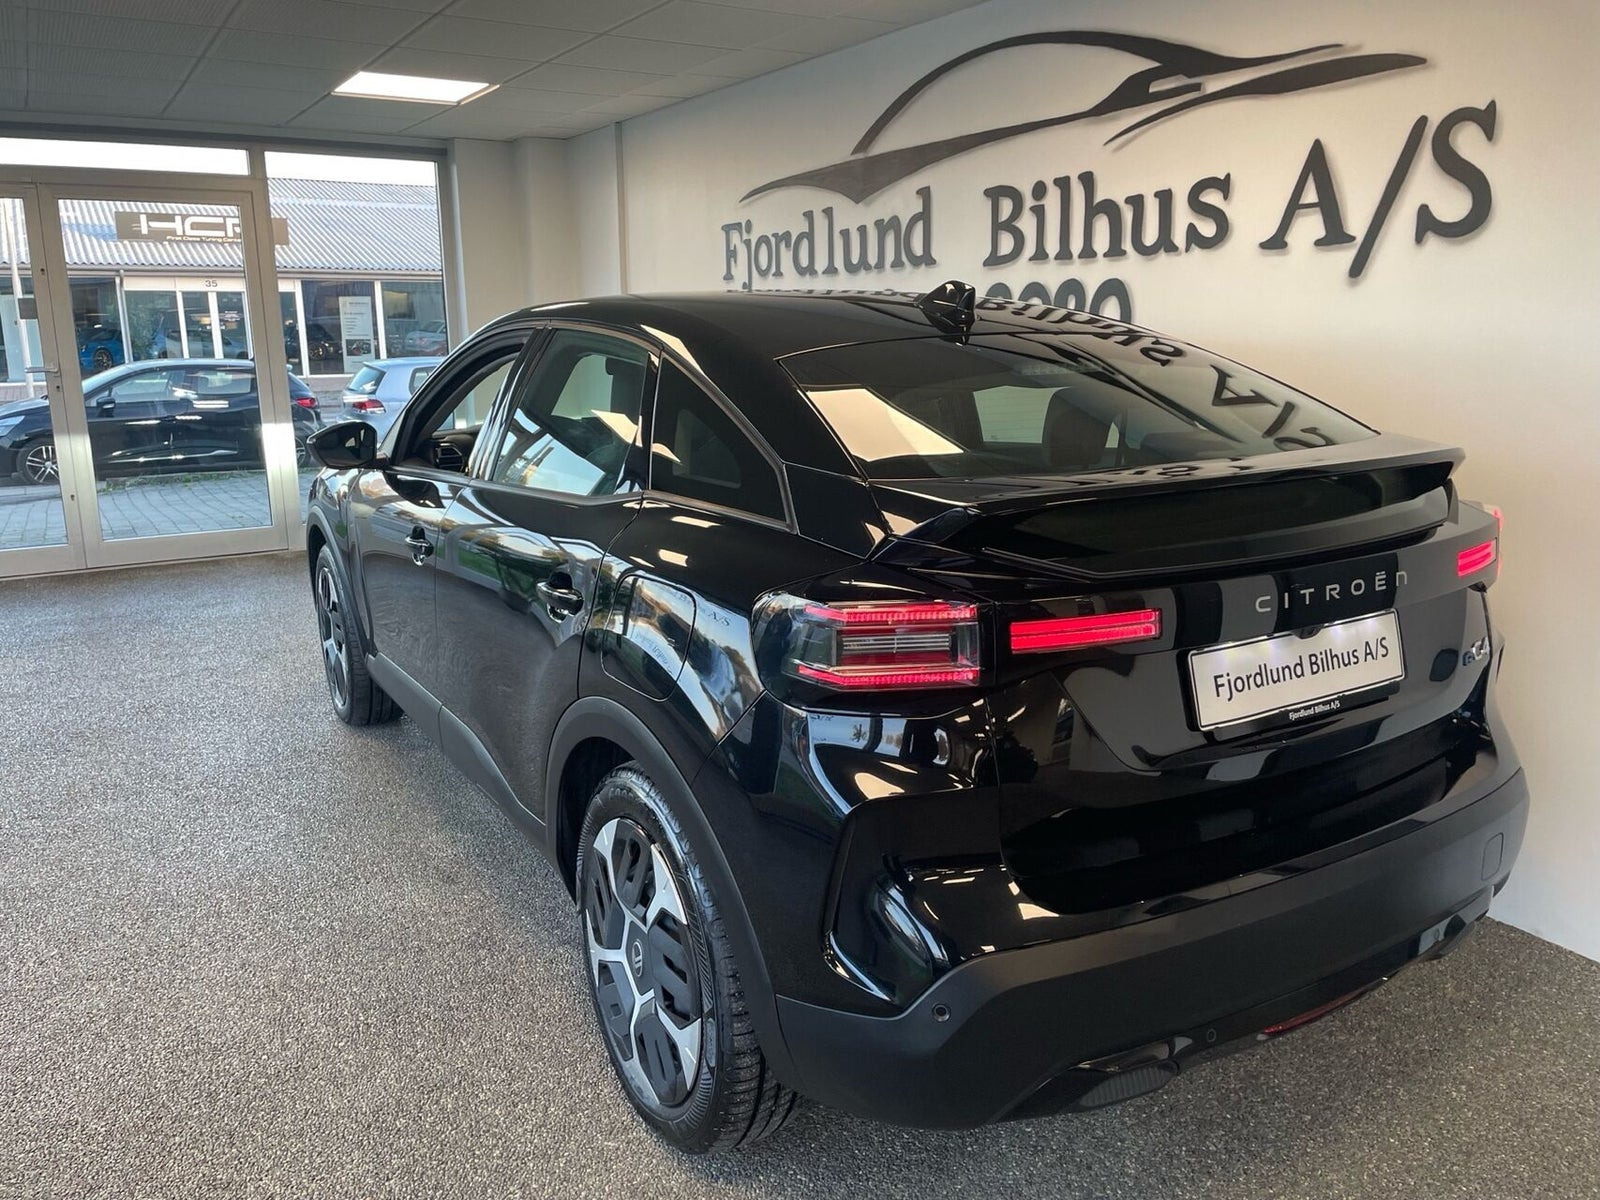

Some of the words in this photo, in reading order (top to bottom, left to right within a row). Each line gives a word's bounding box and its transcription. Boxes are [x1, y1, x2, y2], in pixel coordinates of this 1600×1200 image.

[721, 185, 937, 292] Fjordlund
[983, 170, 1231, 267] Bilhus
[1258, 99, 1497, 279] A/S
[205, 280, 218, 288] 35
[1213, 655, 1305, 701] Fjordlund
[1309, 648, 1360, 675] Bilhus
[1364, 636, 1389, 662] A/S
[1288, 706, 1314, 721] Fjordlund
[1314, 704, 1330, 713] Bilhus
[1330, 700, 1341, 709] A/S
